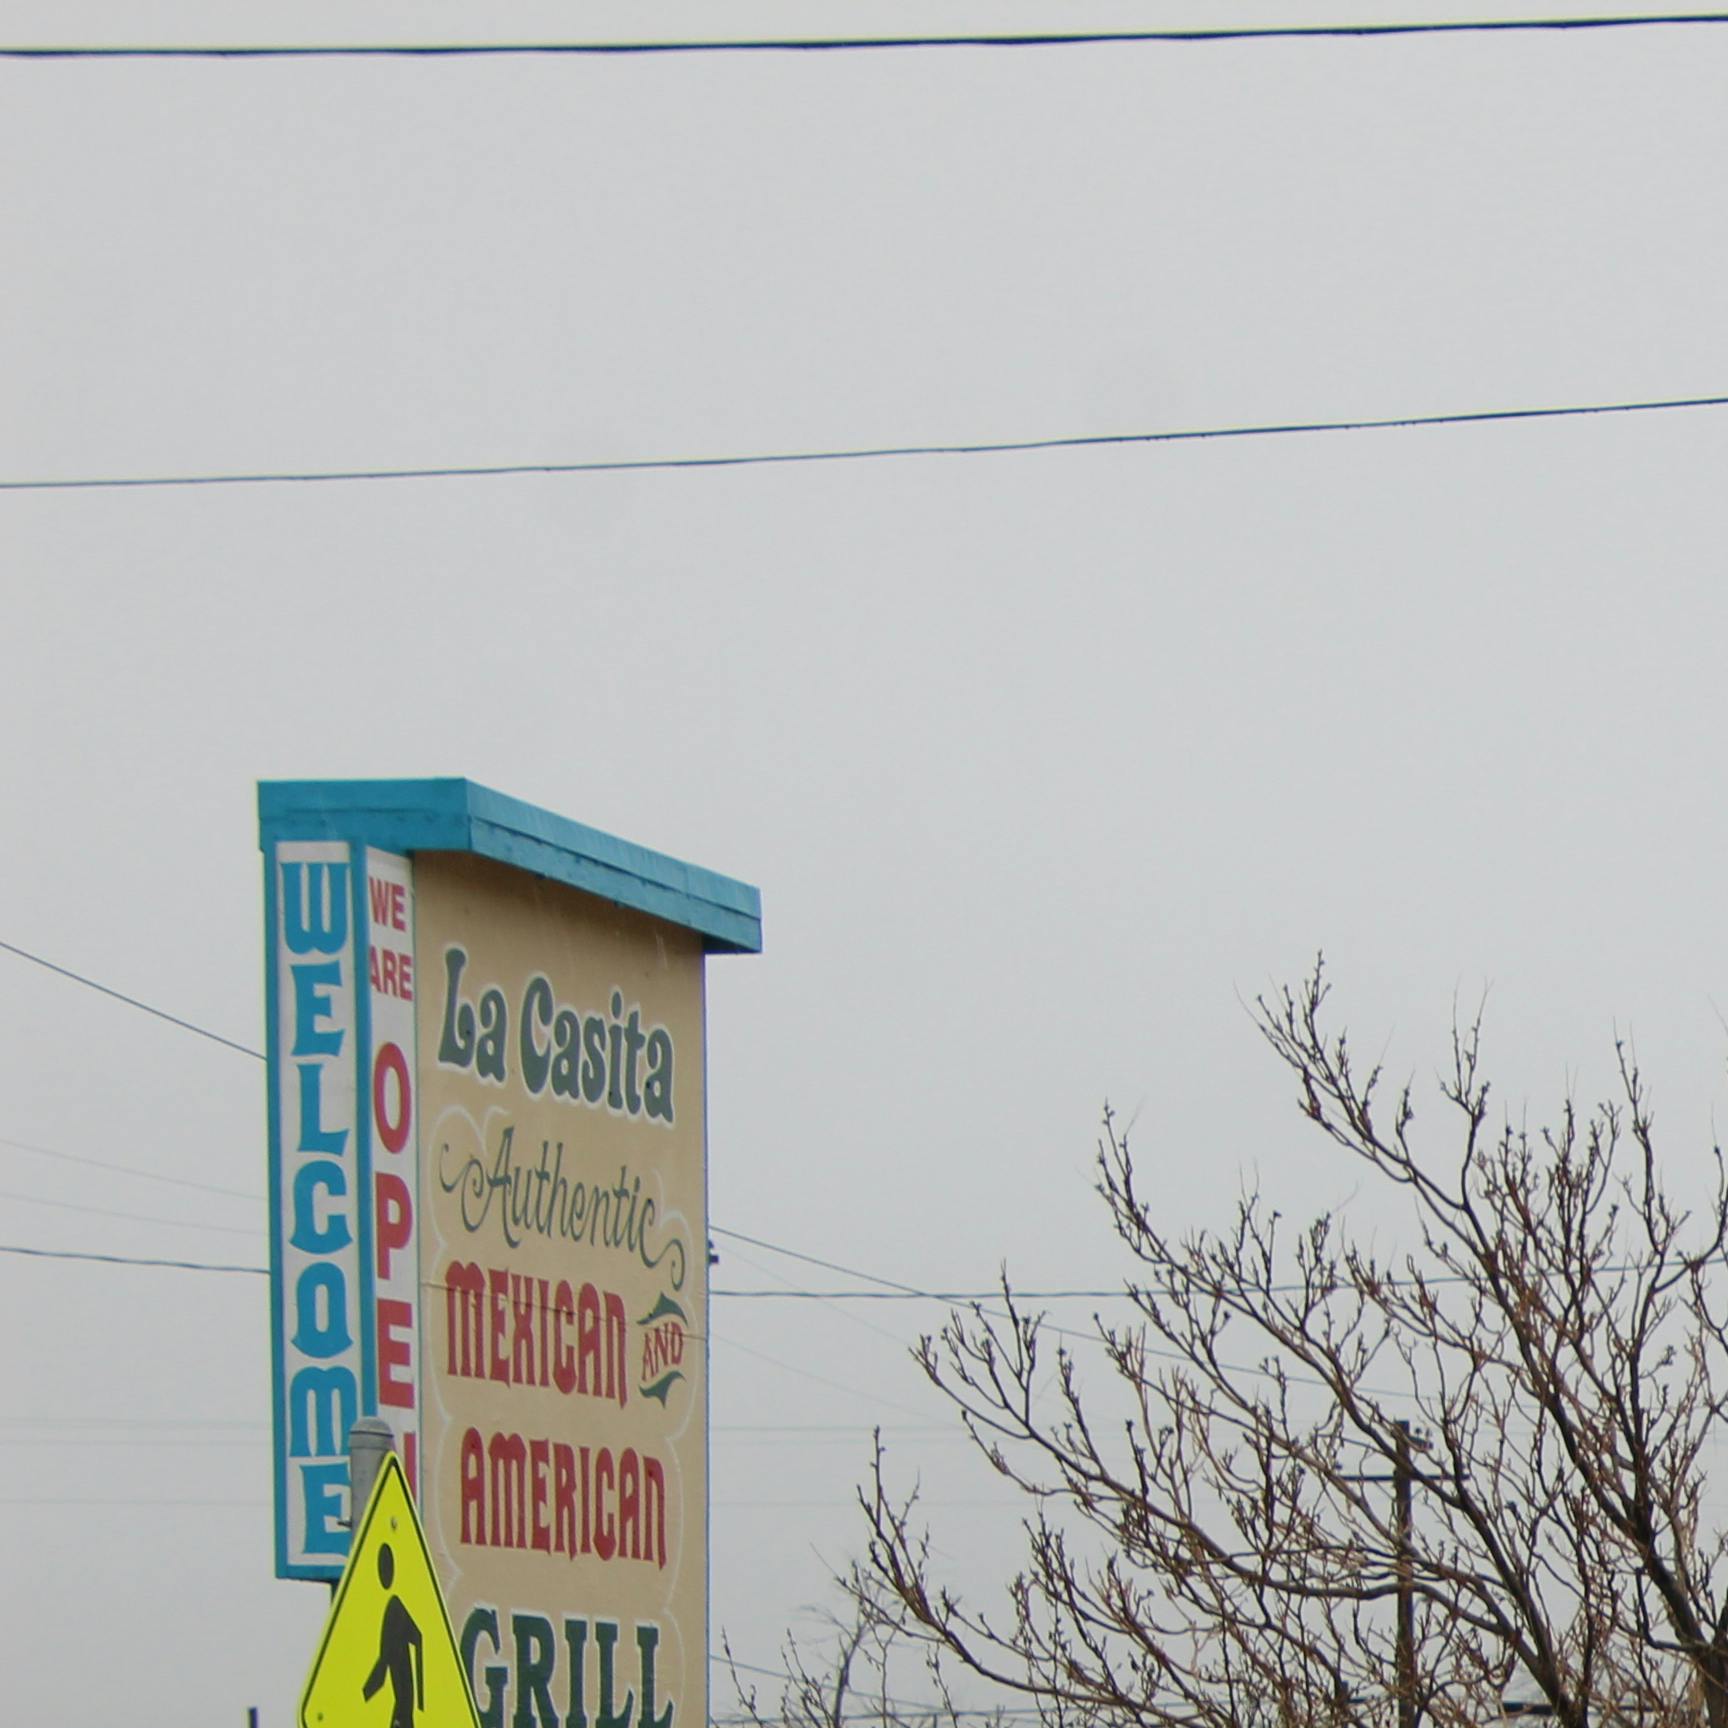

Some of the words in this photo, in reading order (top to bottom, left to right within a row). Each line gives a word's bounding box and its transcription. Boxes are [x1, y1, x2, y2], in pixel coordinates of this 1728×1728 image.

[368, 876, 407, 933] WE
[369, 951, 413, 1001] ARE
[438, 947, 508, 1084] La
[520, 975, 674, 1124] Casita
[280, 862, 357, 1555] WELCOME
[438, 1125, 685, 1293] Authentic
[445, 1259, 628, 1410] MEXICAN
[641, 1321, 686, 1382] AND
[460, 1427, 667, 1570] AMERICAN
